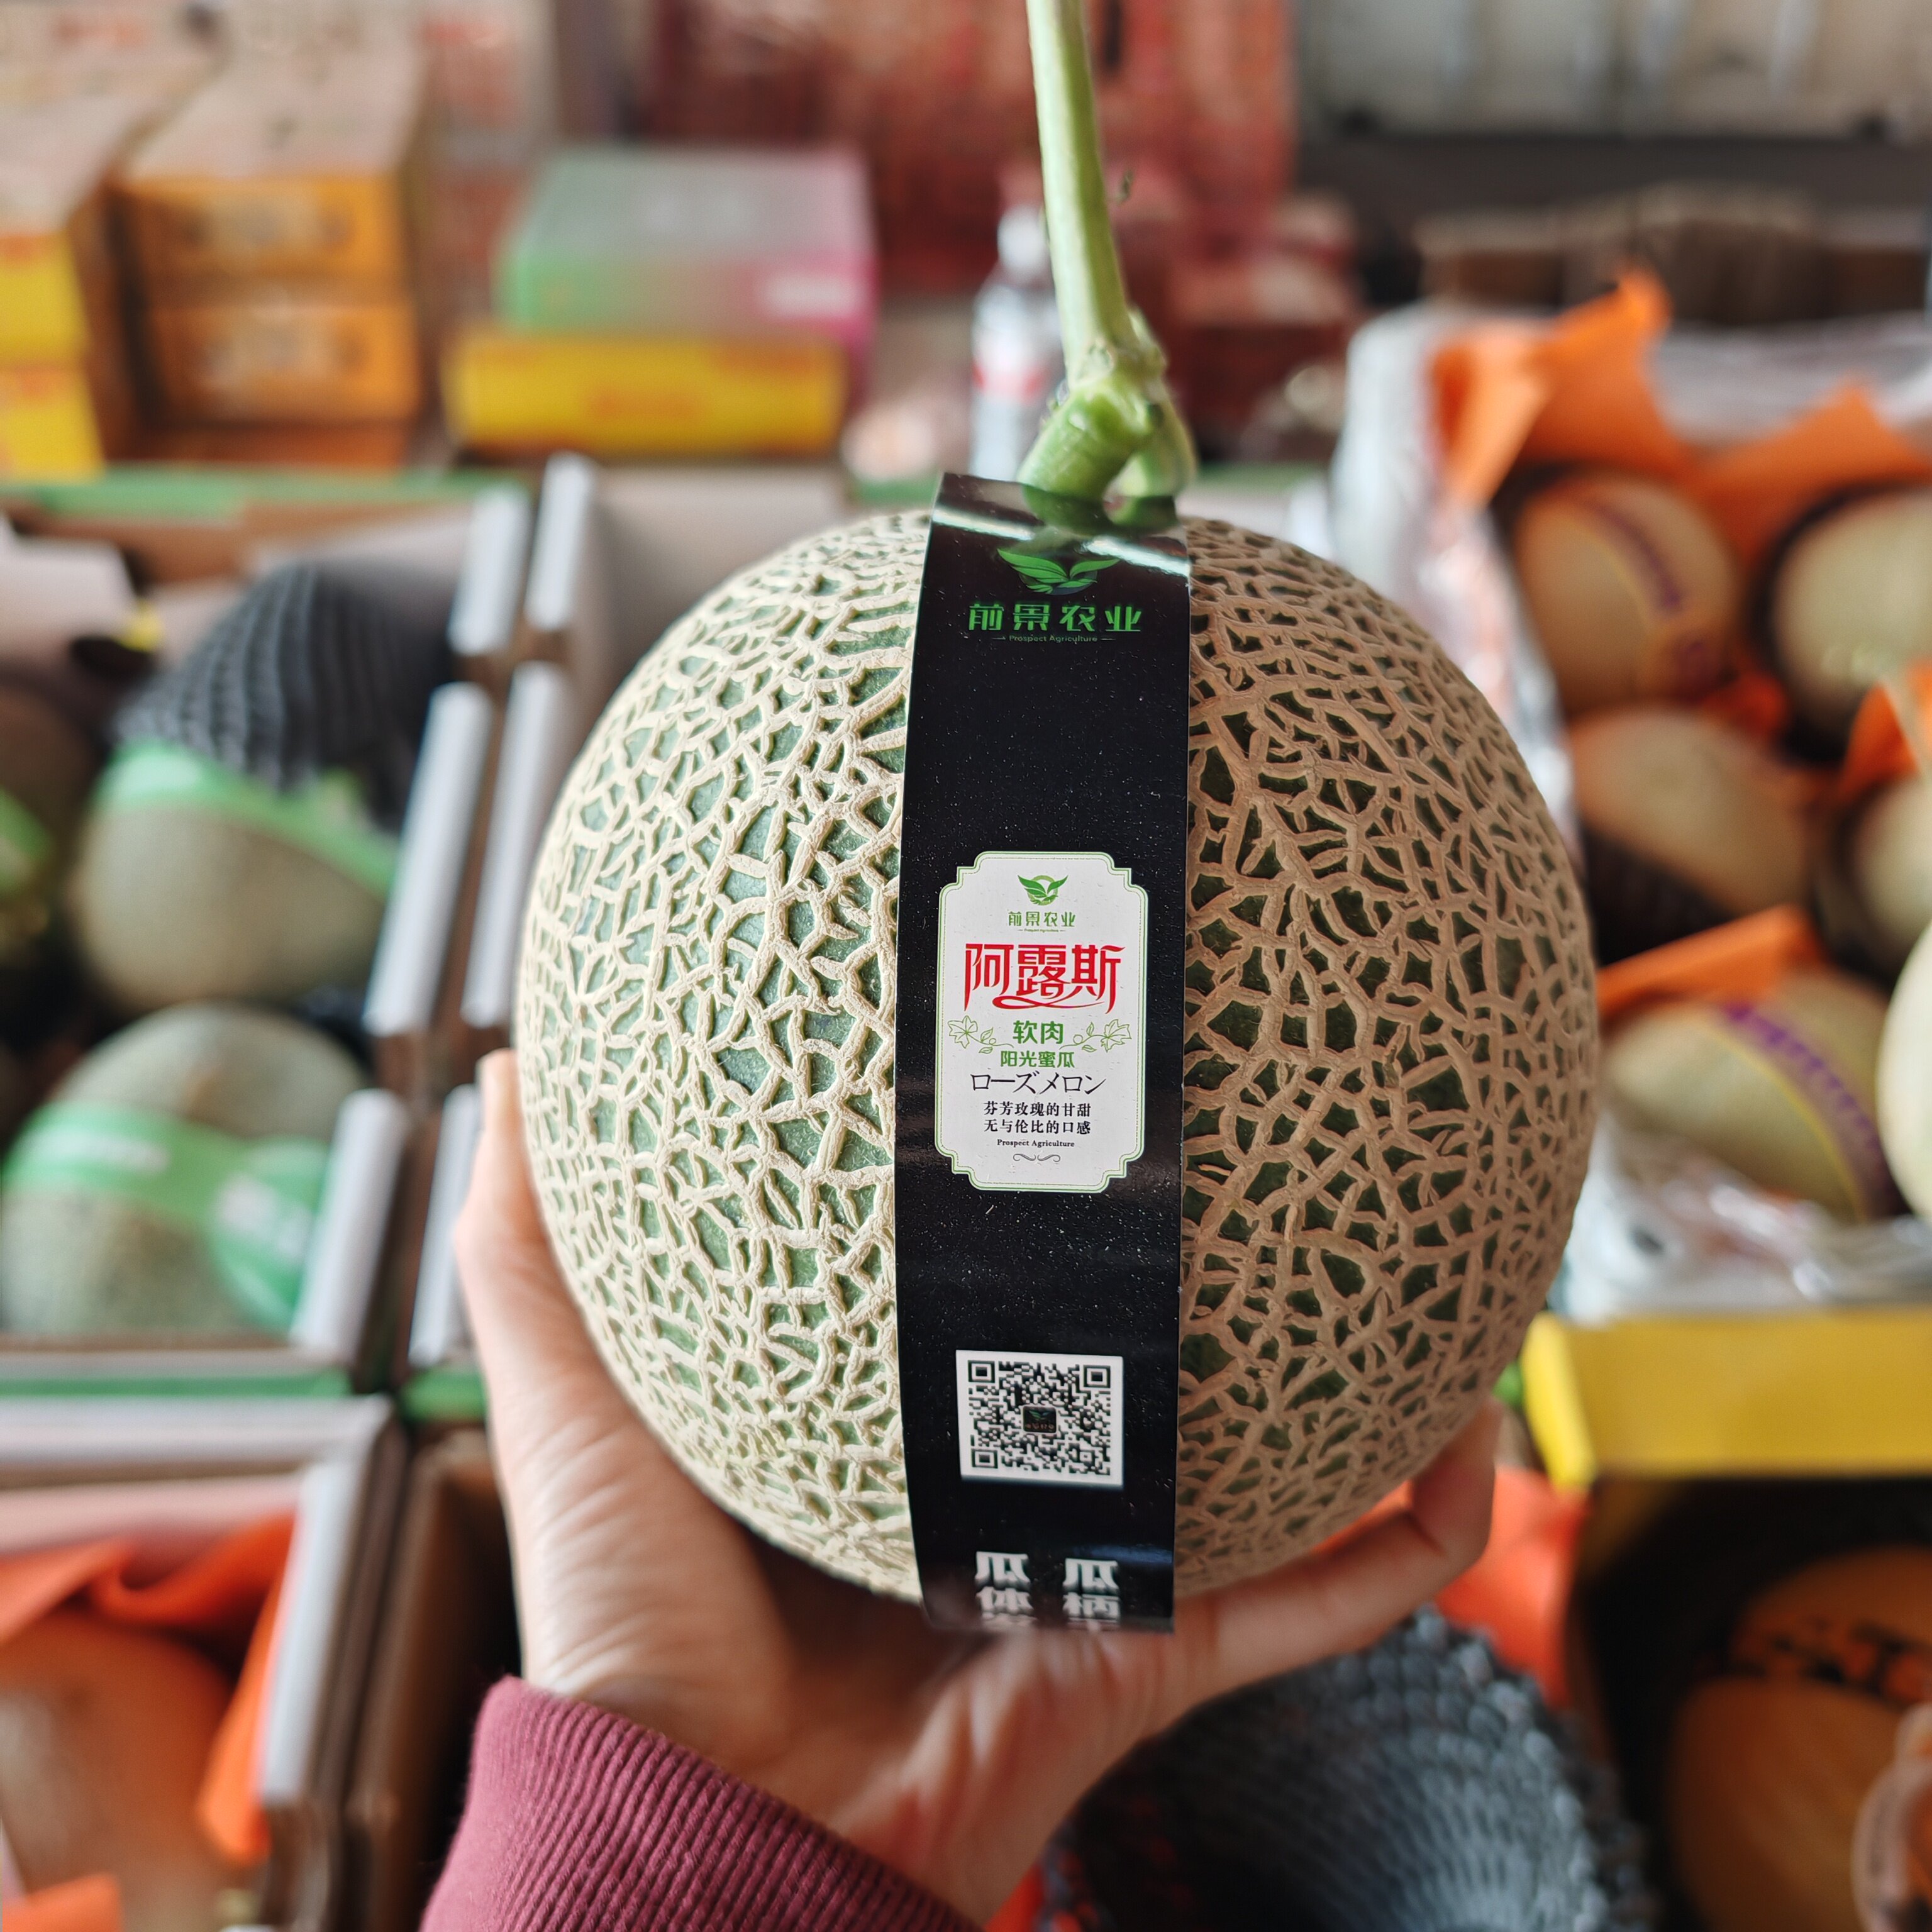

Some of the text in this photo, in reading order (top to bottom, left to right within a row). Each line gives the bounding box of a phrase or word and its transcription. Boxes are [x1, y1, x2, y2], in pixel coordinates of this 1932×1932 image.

[969, 602, 1142, 633] 前景农业
[1009, 635, 1046, 643] Prospect
[1008, 911, 1076, 927] 前景农业
[964, 943, 1126, 1014] 阿露斯
[1013, 1020, 1064, 1045] 软肉
[1000, 1050, 1075, 1069] 阳光蜜瓜
[970, 1070, 1107, 1095] ローズメロン
[983, 1101, 1092, 1118] 芬芳玫瑰的甘甜
[983, 1119, 1091, 1135] 无与伦比的口感
[997, 1139, 1075, 1148] Prospect Agriculture
